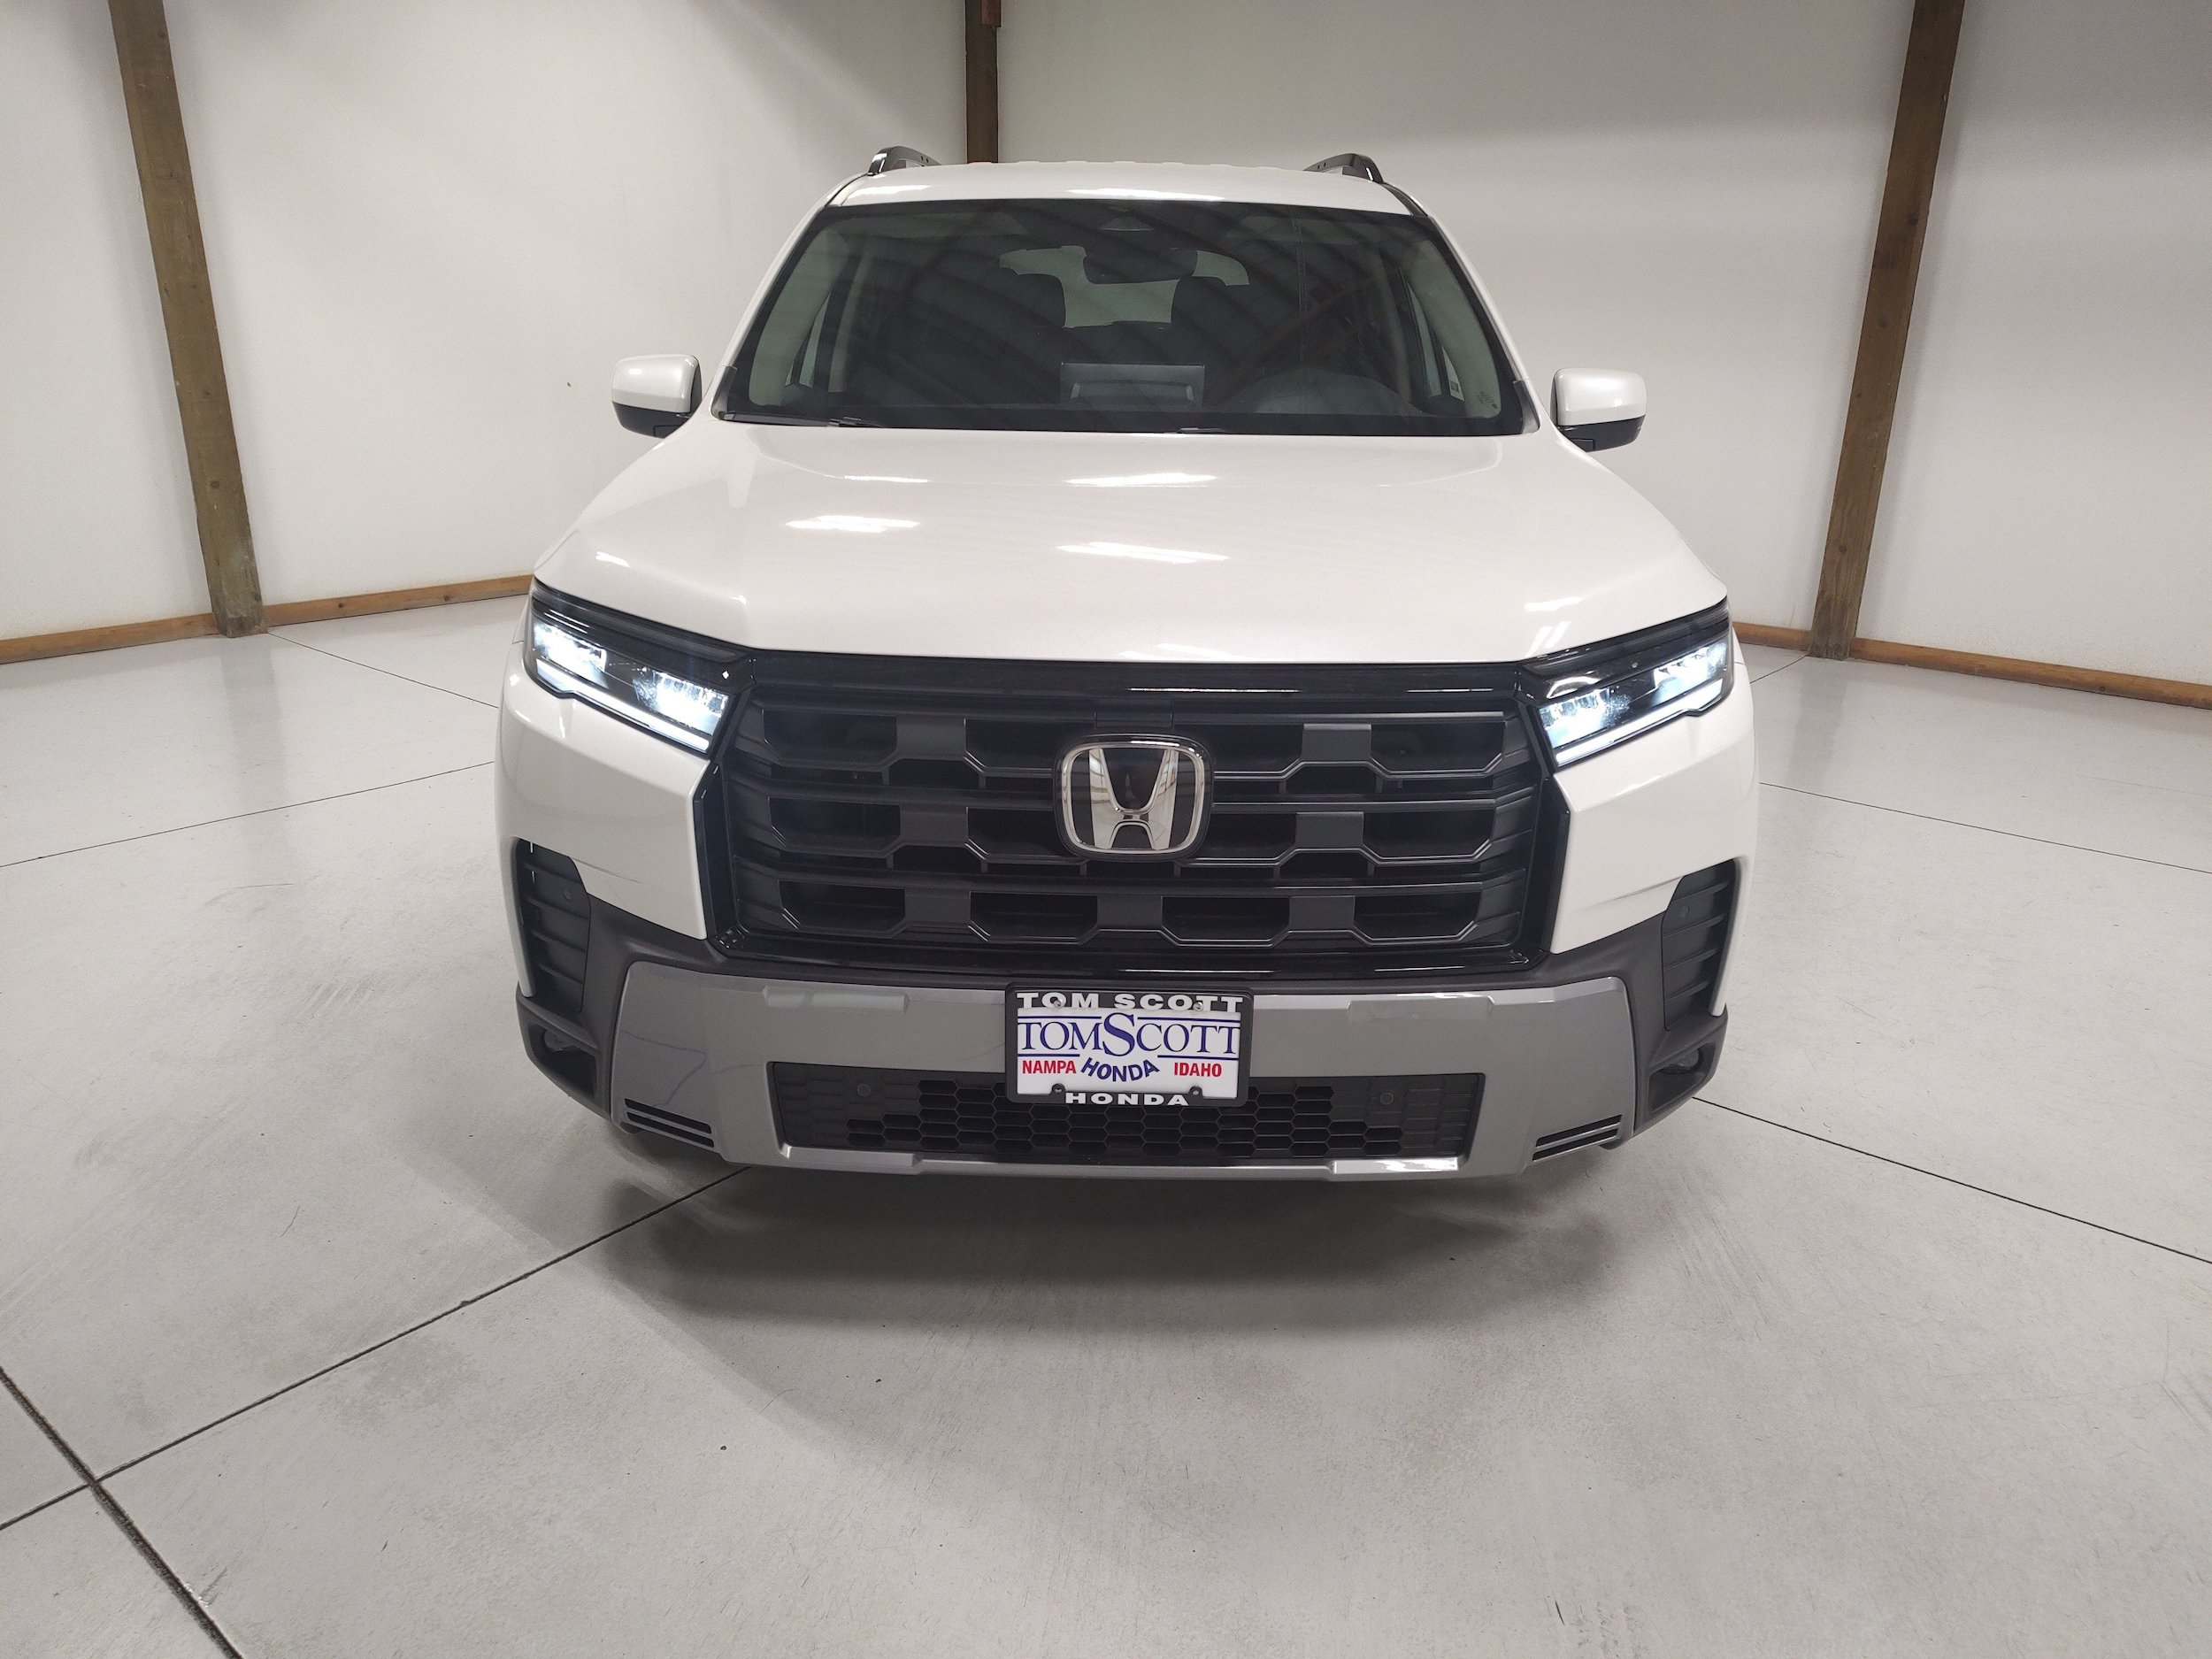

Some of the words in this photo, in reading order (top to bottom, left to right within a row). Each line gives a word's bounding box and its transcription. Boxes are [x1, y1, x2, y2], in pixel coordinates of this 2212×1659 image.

[1017, 992, 1099, 1009] TOM
[1114, 994, 1243, 1012] SCOTT
[1022, 1060, 1077, 1074] NAMPA
[1080, 1057, 1160, 1082] HONDA
[1173, 1062, 1222, 1077] IDAHO
[1065, 1092, 1189, 1105] HONDA
